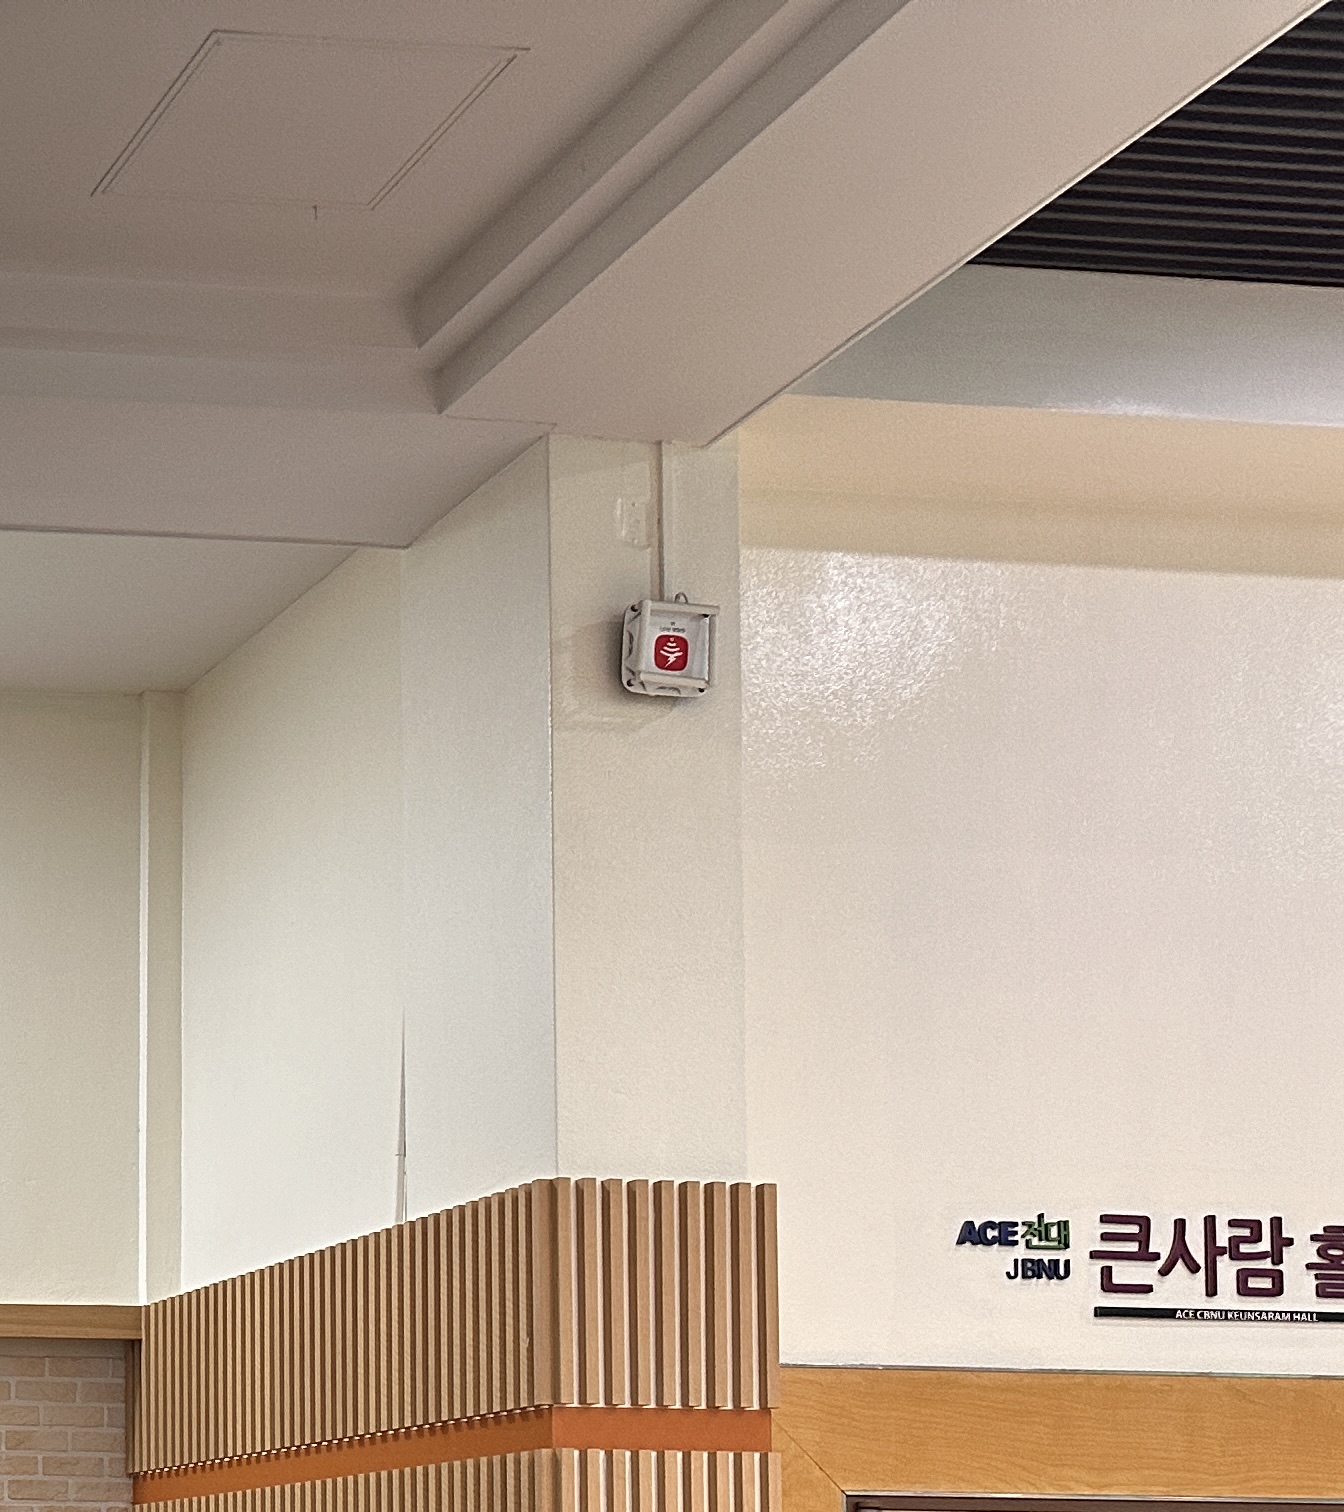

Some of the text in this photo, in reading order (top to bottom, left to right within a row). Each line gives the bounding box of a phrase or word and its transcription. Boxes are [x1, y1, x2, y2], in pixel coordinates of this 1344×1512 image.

[1090, 1214, 1344, 1298] 큰사람 홀
[1006, 1258, 1070, 1280] JBNU
[1176, 1309, 1318, 1322] ACE CBNU KEUNSARAM HALL
